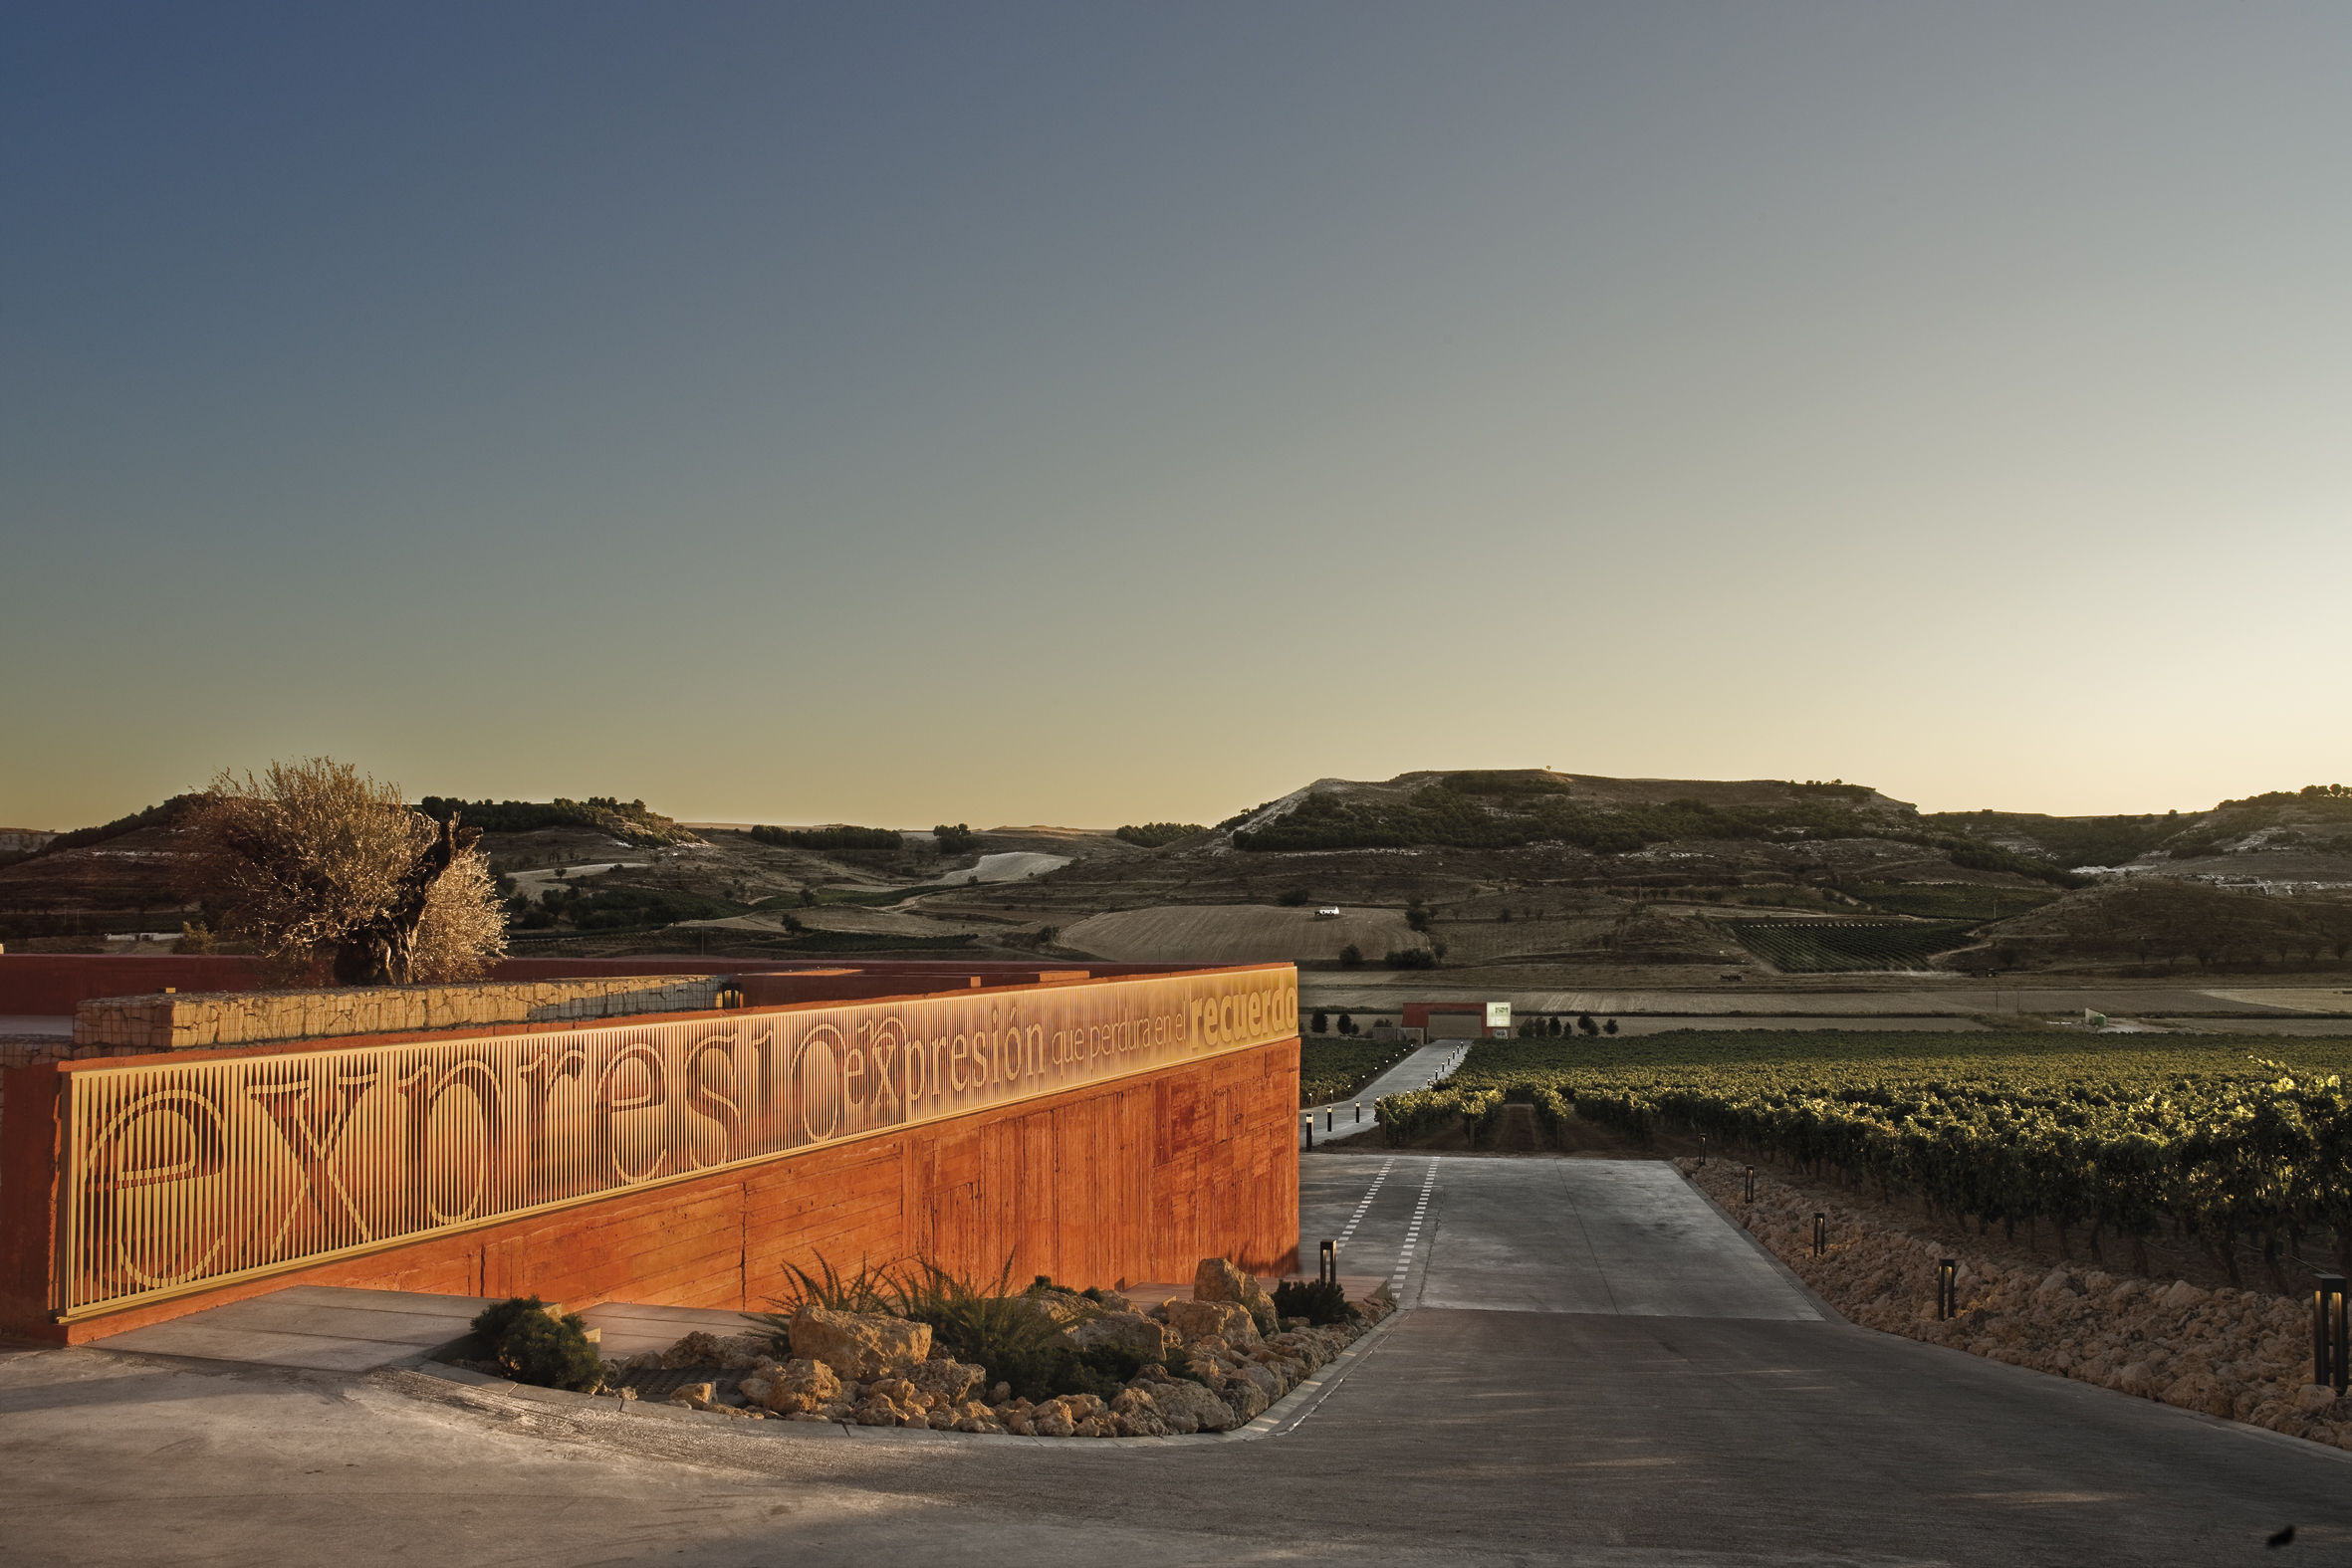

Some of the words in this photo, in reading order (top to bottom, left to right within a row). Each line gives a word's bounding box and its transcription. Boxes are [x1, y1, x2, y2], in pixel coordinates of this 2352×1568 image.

[844, 1007, 1045, 1111] expresión
[1052, 1027, 1085, 1081] que
[1089, 1008, 1151, 1072] perdura
[1154, 1011, 1172, 1045] en
[1175, 999, 1186, 1042] el
[1191, 974, 1297, 1049] recuerdo
